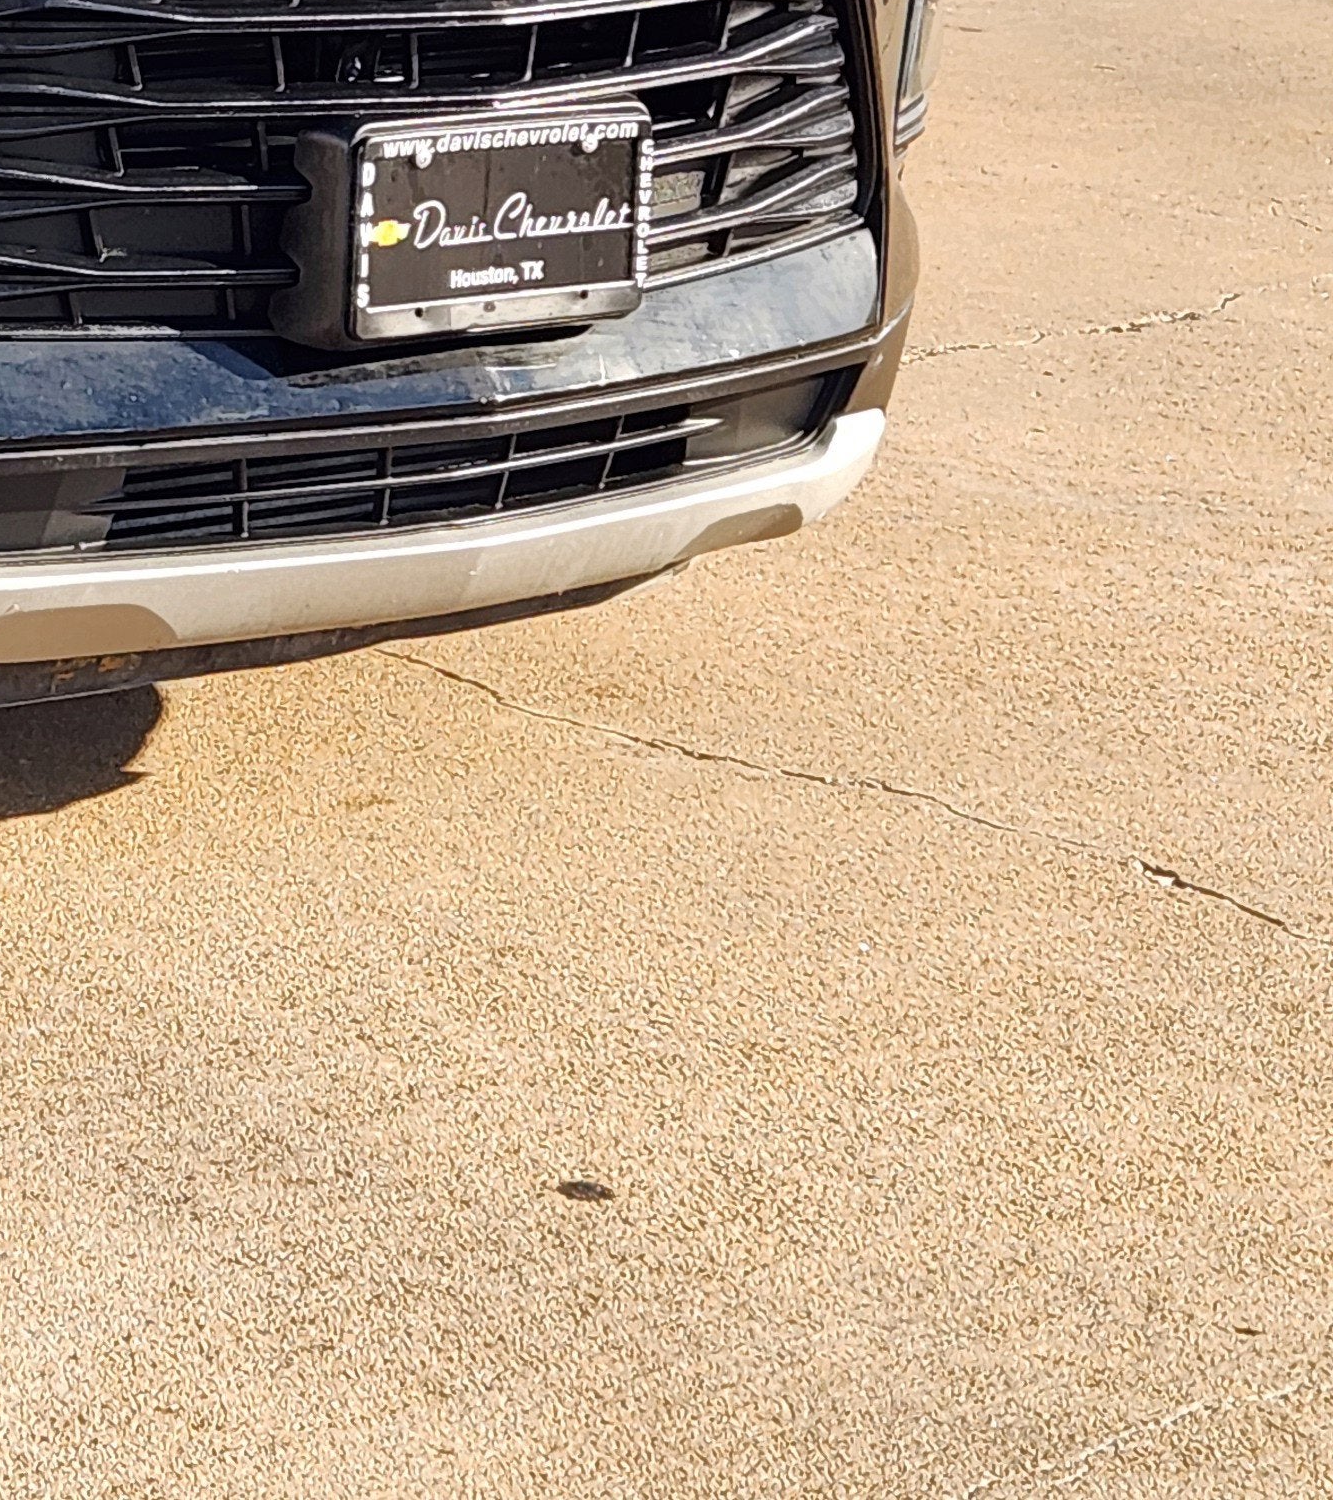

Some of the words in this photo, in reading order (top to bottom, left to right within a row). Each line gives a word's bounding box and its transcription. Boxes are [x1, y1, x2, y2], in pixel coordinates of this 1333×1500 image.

[383, 122, 639, 159] www.davischevrolet.com
[356, 161, 376, 308] DAVIS
[413, 199, 493, 250] Davis
[493, 192, 635, 240] Chevrolet
[635, 138, 655, 289] CHEVROLET
[450, 268, 518, 289] Houston,
[519, 260, 544, 280] TX
